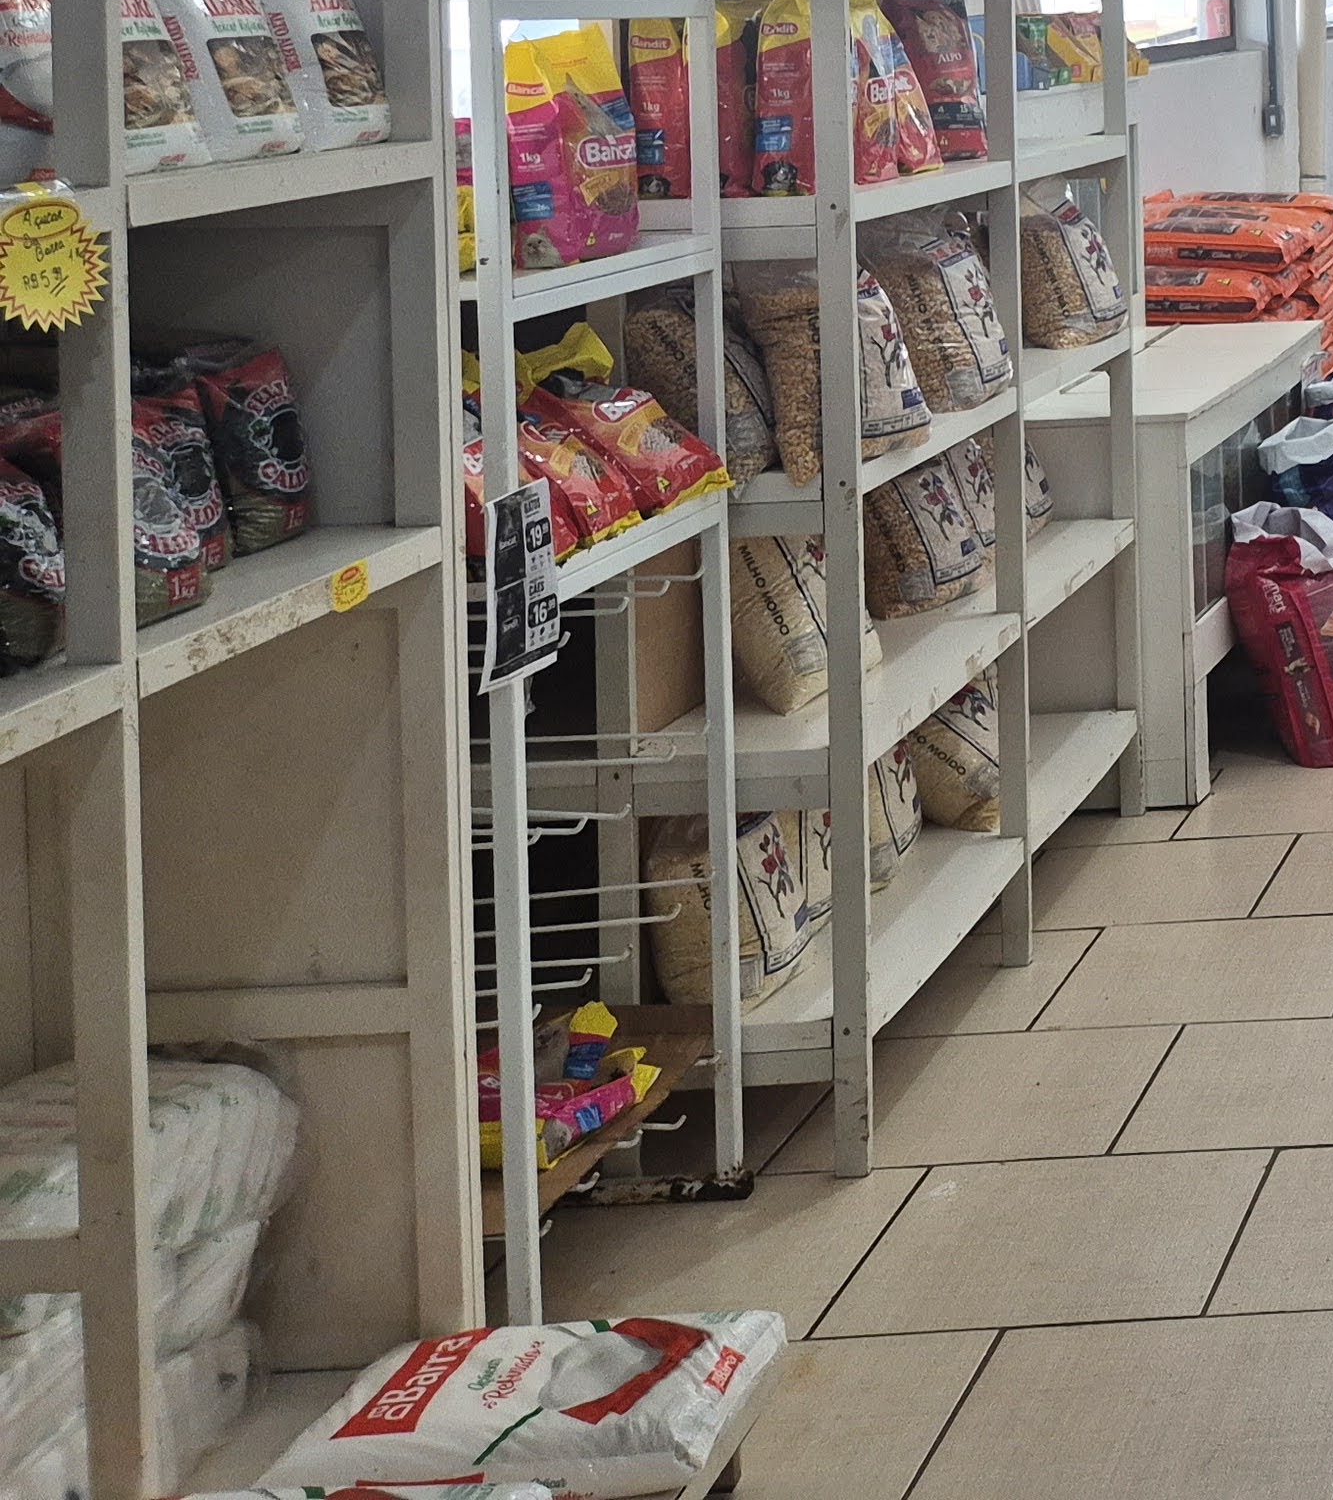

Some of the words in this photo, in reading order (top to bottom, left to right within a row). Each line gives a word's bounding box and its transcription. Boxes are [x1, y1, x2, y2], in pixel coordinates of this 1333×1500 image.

[631, 36, 671, 50] Bandit
[772, 88, 791, 100] 1kg
[642, 102, 661, 114] 1kg
[519, 152, 542, 165] 1kg
[738, 545, 766, 588] MILHO
[762, 591, 789, 636] MOÍDO
[532, 601, 548, 625] 16
[927, 743, 967, 777] MOÍDO
